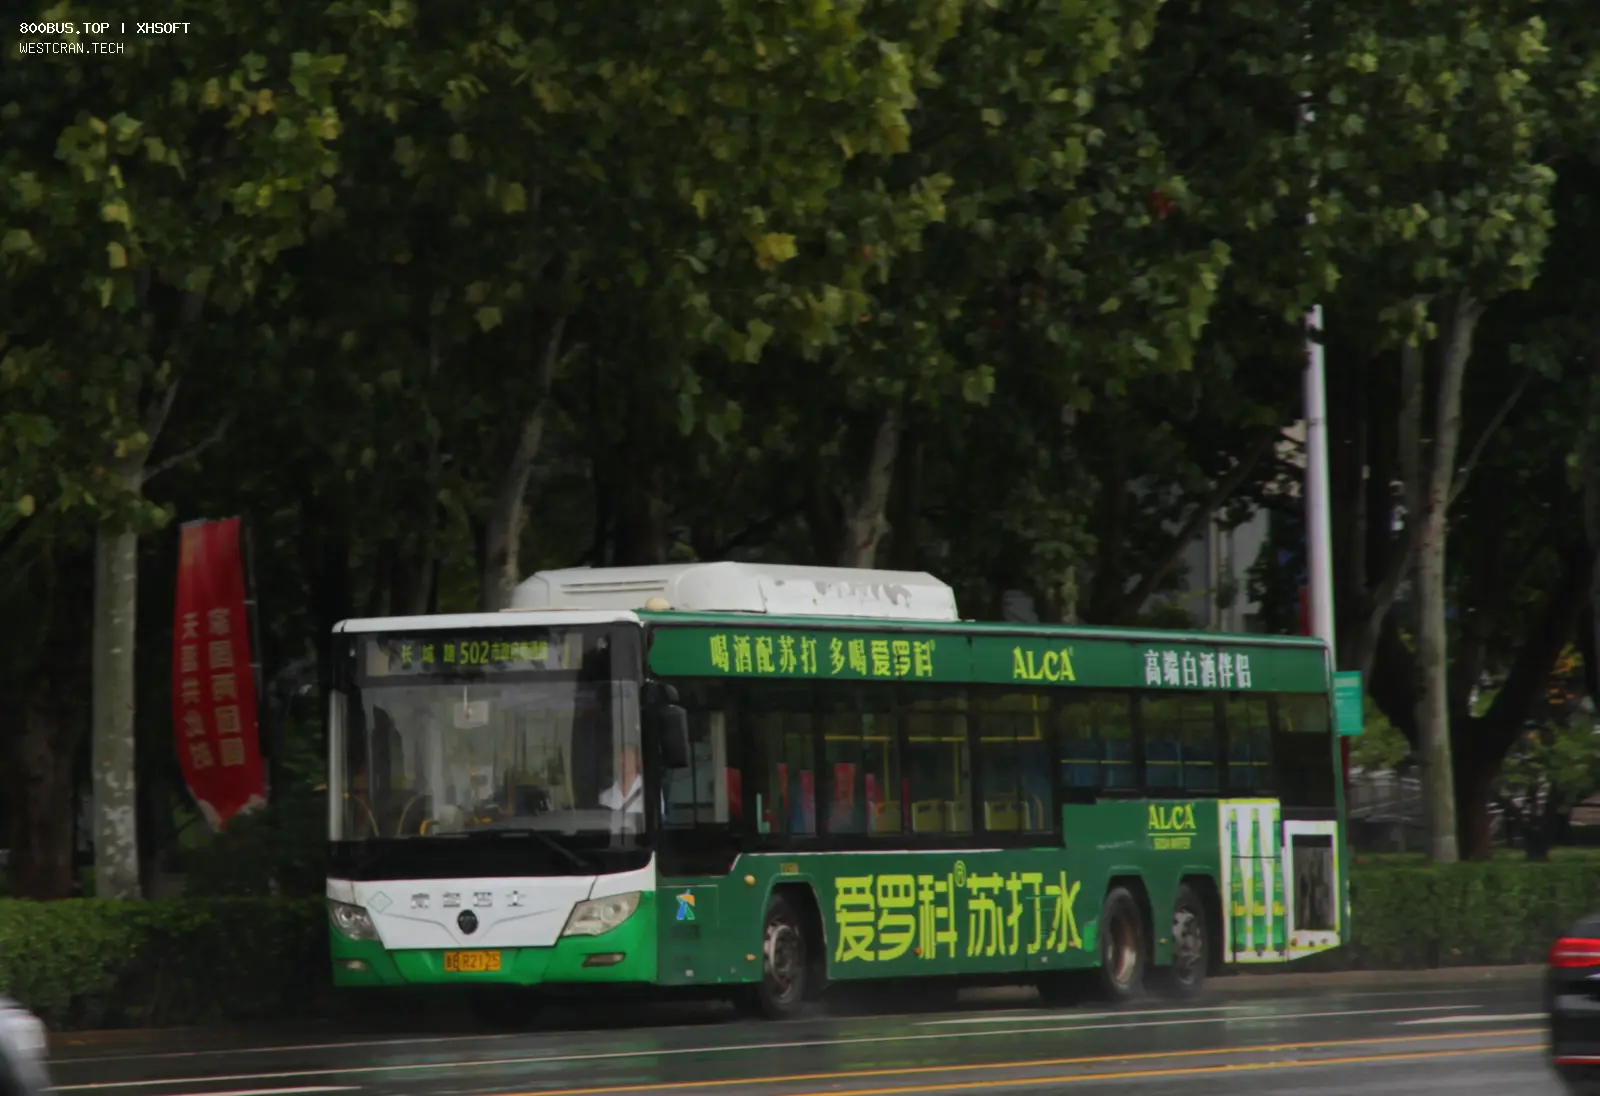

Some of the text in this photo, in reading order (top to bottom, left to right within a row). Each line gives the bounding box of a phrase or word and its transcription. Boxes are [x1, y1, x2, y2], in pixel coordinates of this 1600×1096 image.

[460, 641, 490, 665] 502
[709, 634, 817, 675] 喝酒配苏打
[1013, 646, 1075, 682] ALCA
[1144, 649, 1252, 689] 高端白酒伴侣
[1148, 803, 1196, 830] ALCA
